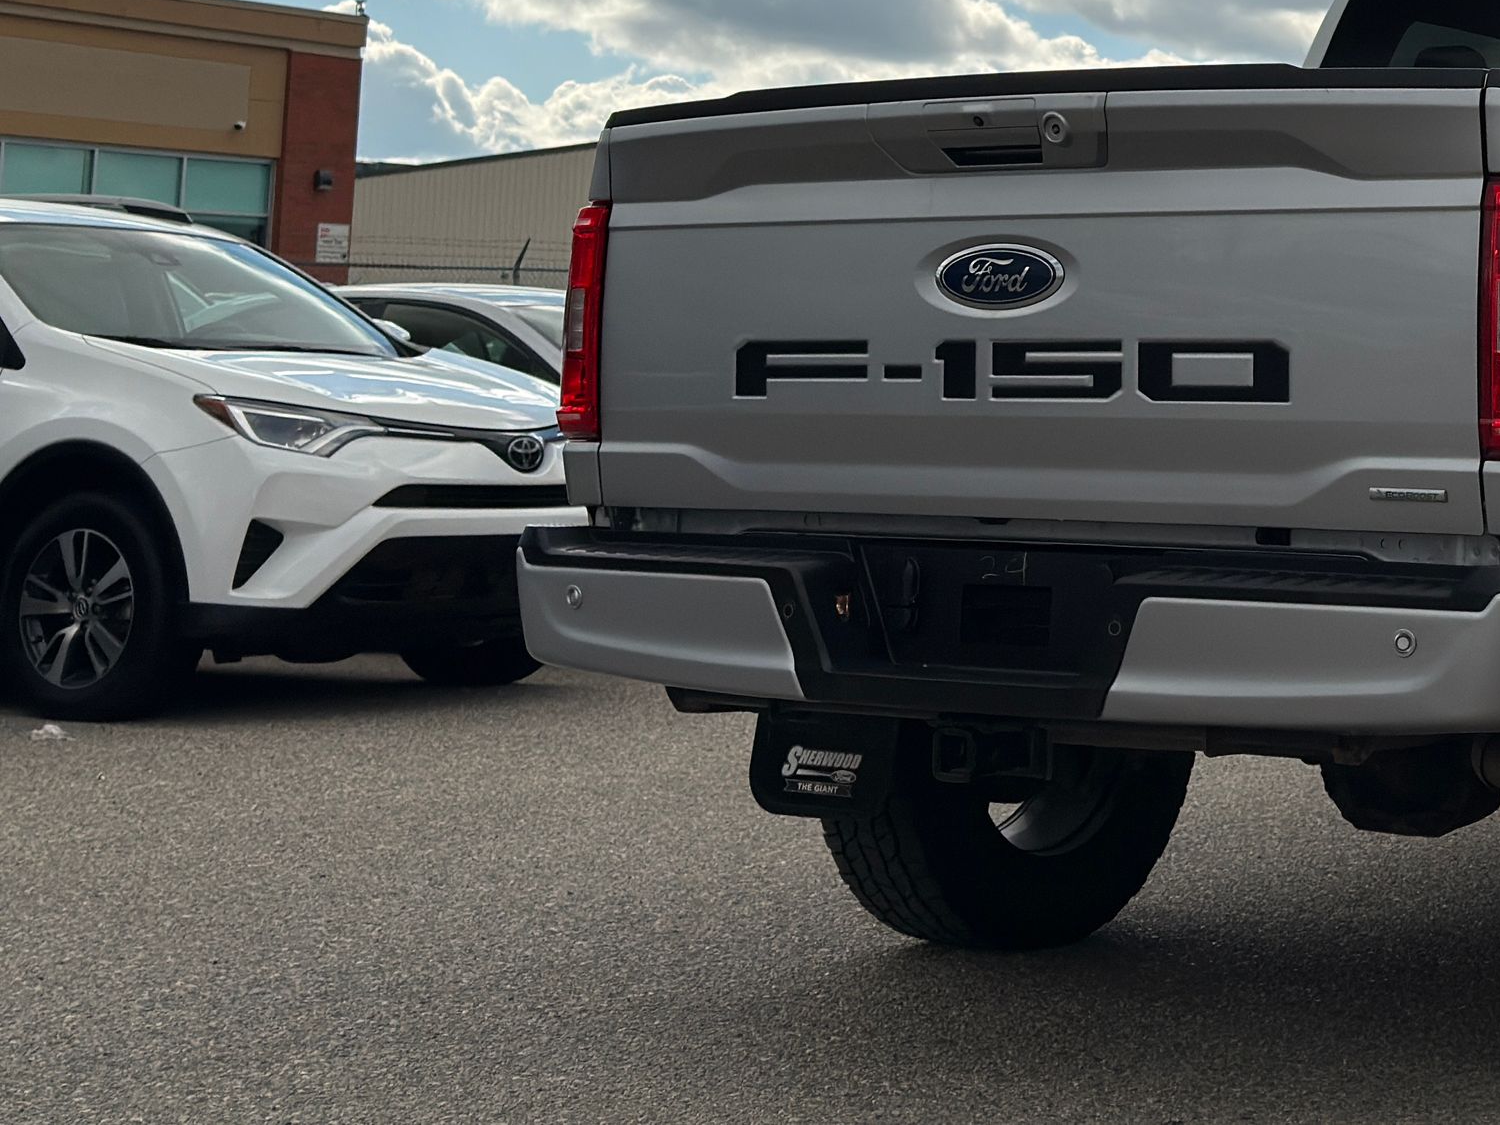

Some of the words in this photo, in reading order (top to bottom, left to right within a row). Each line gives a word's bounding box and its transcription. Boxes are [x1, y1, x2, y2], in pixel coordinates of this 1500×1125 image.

[961, 257, 1030, 293] Ford
[733, 338, 1292, 405] F-150
[781, 745, 862, 776] SHERWOOD
[797, 782, 812, 791] THE
[814, 784, 838, 794] GIANT
